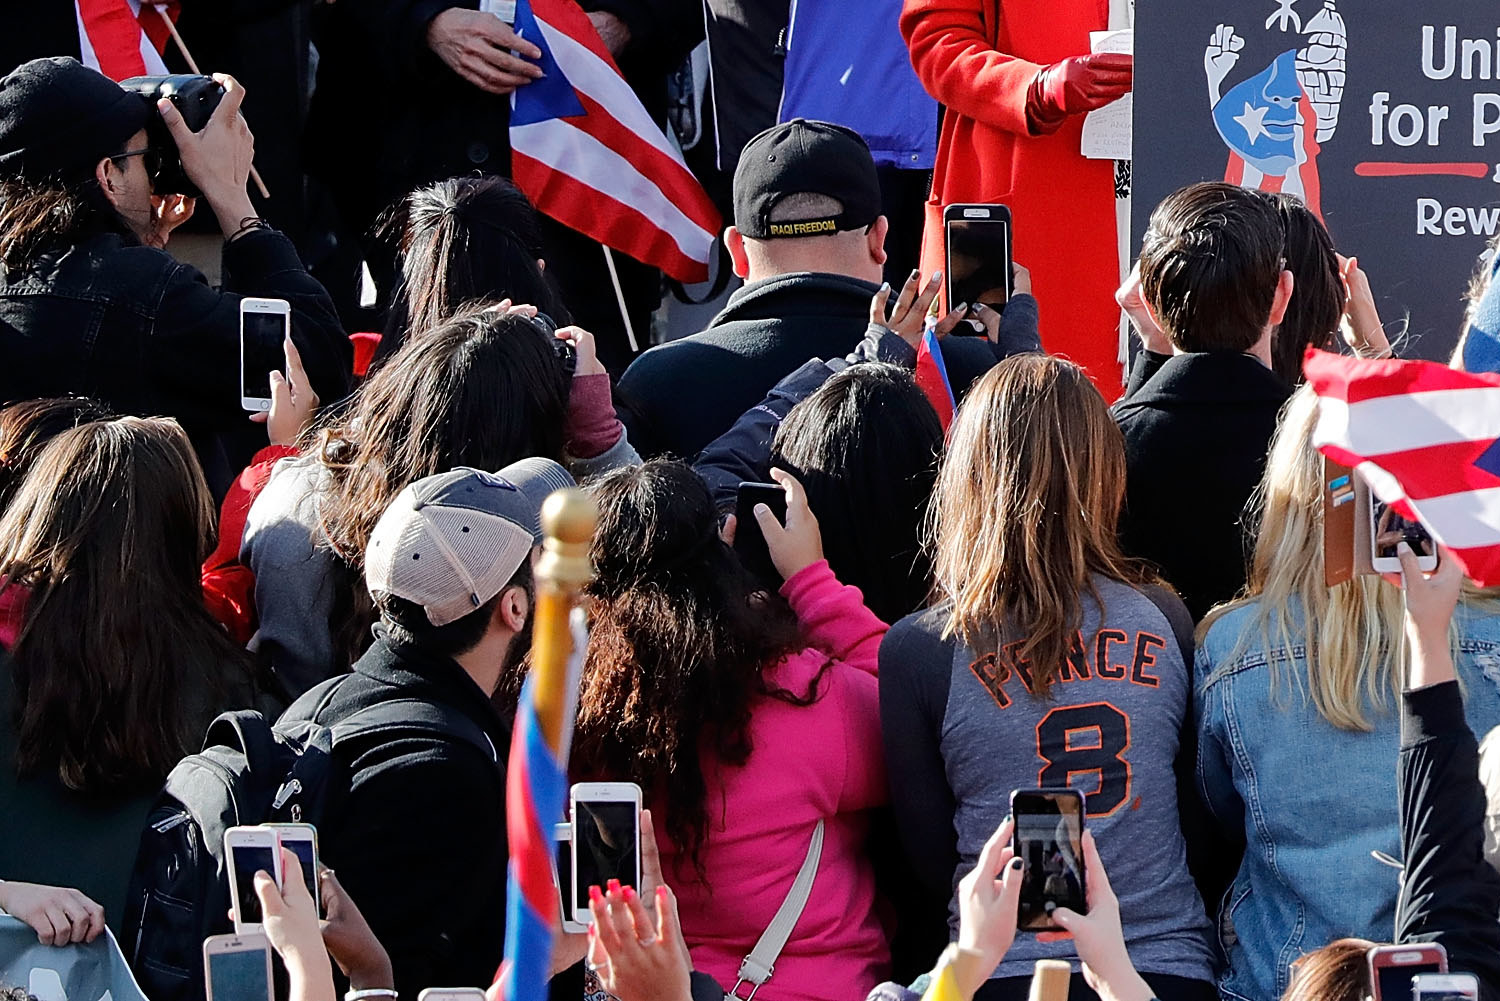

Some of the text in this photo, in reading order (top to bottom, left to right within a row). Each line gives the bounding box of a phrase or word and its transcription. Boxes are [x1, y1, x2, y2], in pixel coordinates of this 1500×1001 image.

[1369, 92, 1449, 146] for
[770, 220, 837, 235] IRAQI FREEDOM
[1035, 701, 1132, 818] 8
